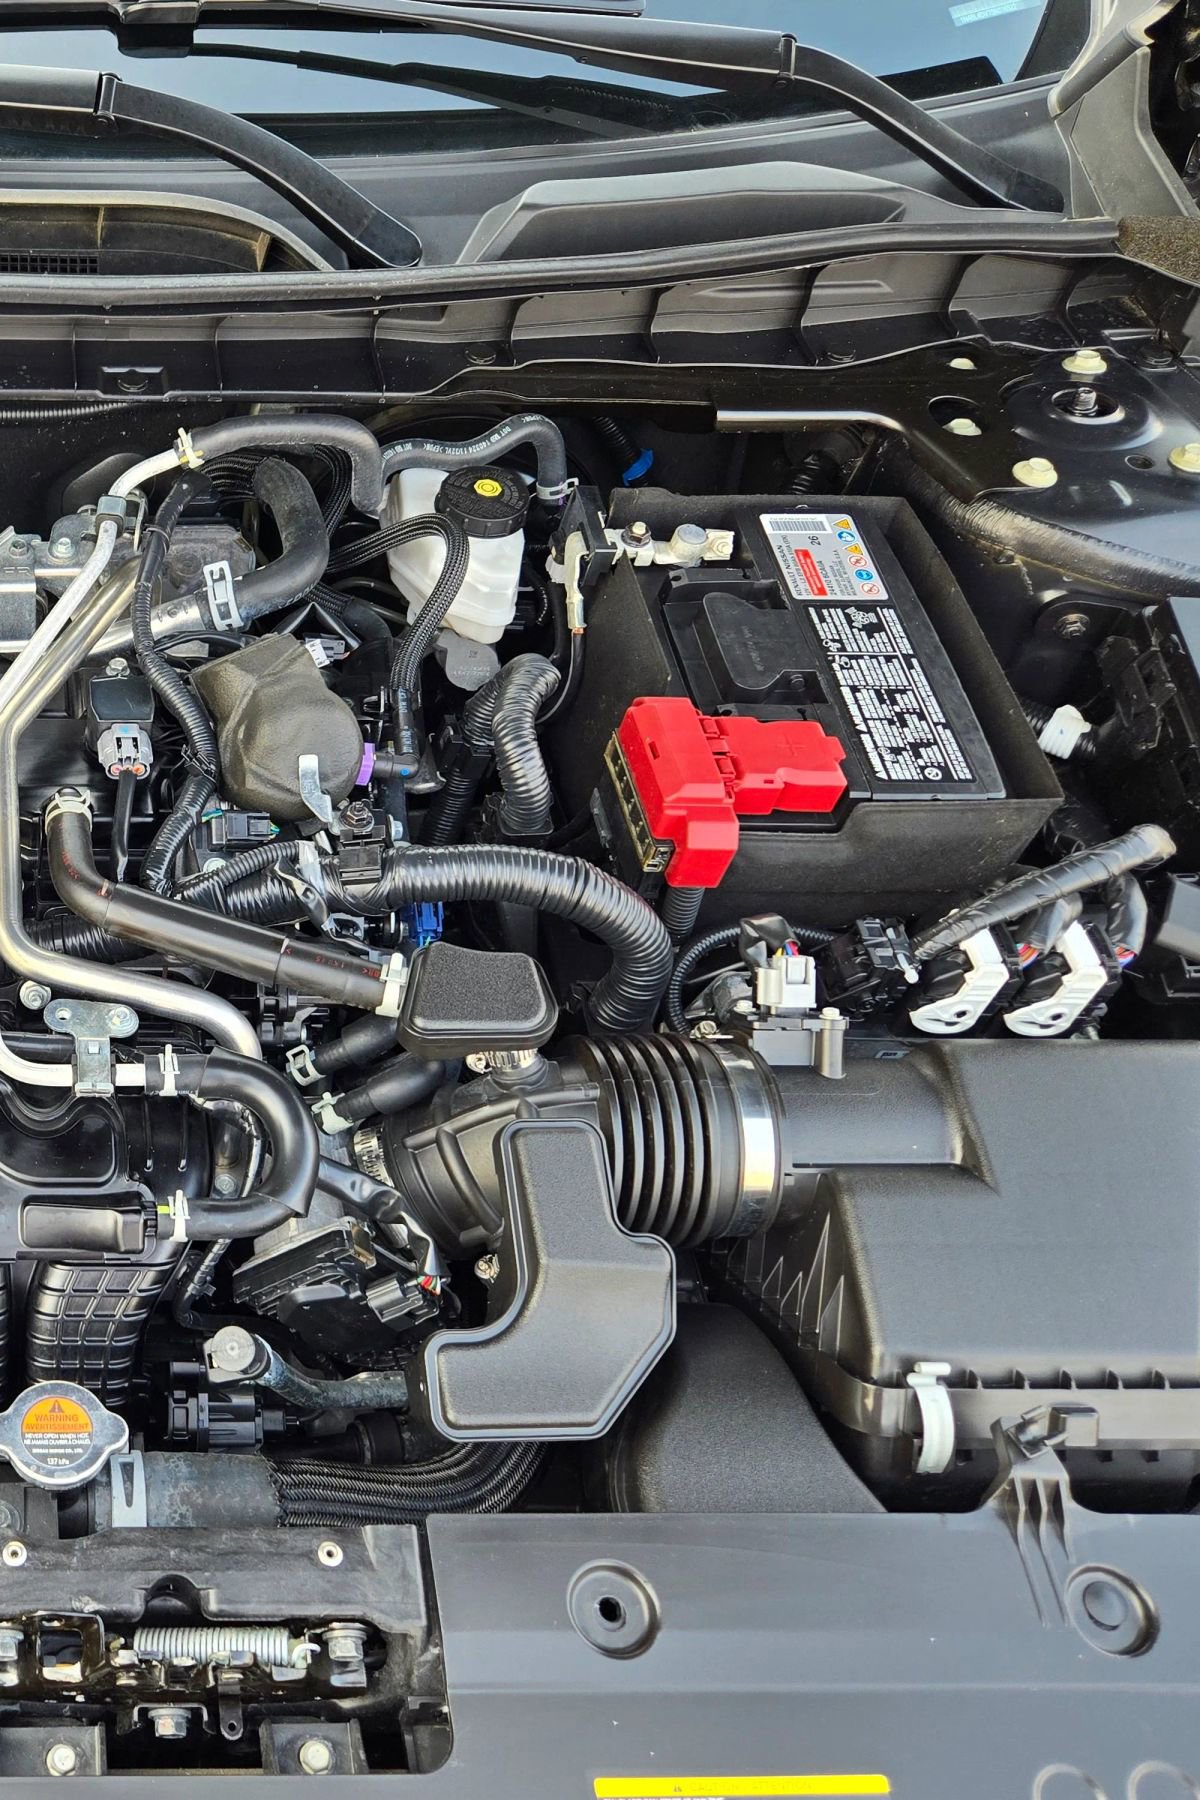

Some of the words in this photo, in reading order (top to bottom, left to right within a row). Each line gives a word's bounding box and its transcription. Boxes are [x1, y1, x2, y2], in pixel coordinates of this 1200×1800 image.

[807, 535, 821, 545] 26
[775, 544, 792, 569] NISSAN
[787, 571, 803, 595] RENAULT
[824, 579, 837, 595] 24410
